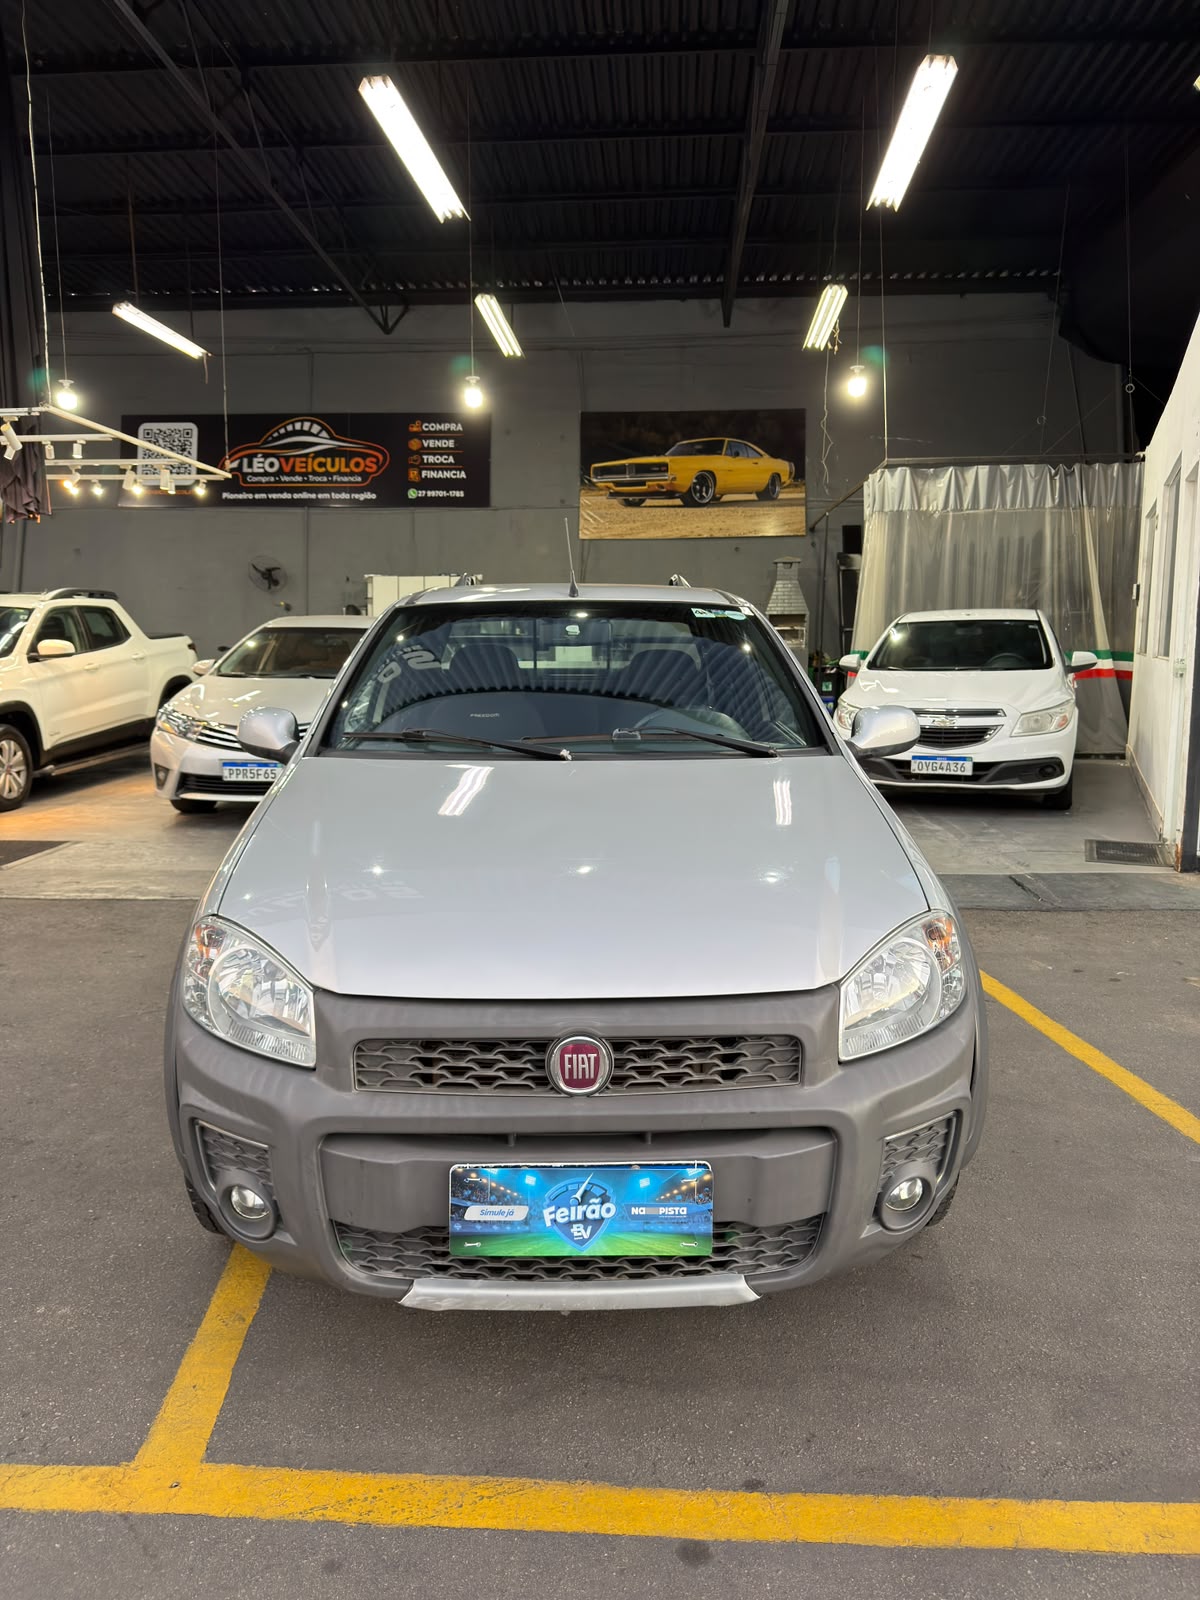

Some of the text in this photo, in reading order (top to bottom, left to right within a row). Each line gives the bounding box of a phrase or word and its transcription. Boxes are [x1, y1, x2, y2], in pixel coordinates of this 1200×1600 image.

[422, 422, 463, 431] COMPRA
[422, 440, 455, 448] VENDE
[422, 455, 455, 464] TROCA
[421, 470, 467, 478] FINANCIA
[246, 475, 275, 483] Compra
[222, 492, 254, 500] Pioneiro
[268, 492, 292, 500] venda
[292, 492, 316, 500] online
[331, 492, 350, 500] toda
[351, 491, 377, 501] região
[228, 768, 277, 780] PPR5F65
[564, 1054, 597, 1080] FIAT
[480, 1208, 515, 1218] Simule já
[543, 1198, 617, 1228] Feirão
